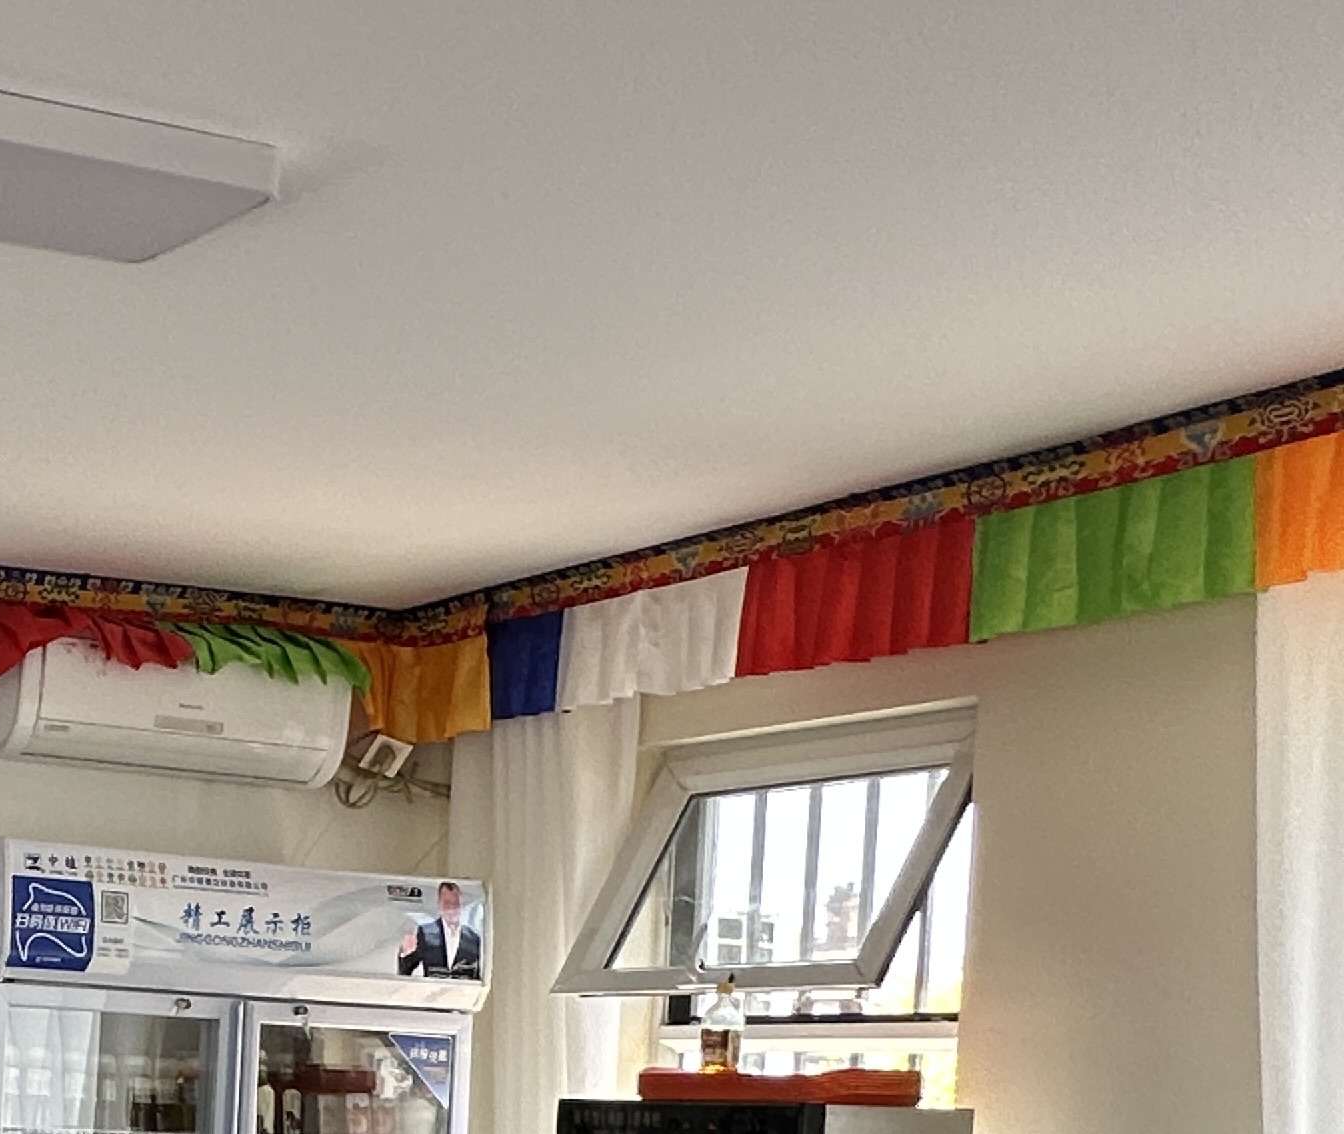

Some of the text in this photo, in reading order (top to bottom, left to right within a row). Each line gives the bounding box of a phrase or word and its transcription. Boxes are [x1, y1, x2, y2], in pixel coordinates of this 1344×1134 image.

[180, 902, 312, 937] 精工展示柜
